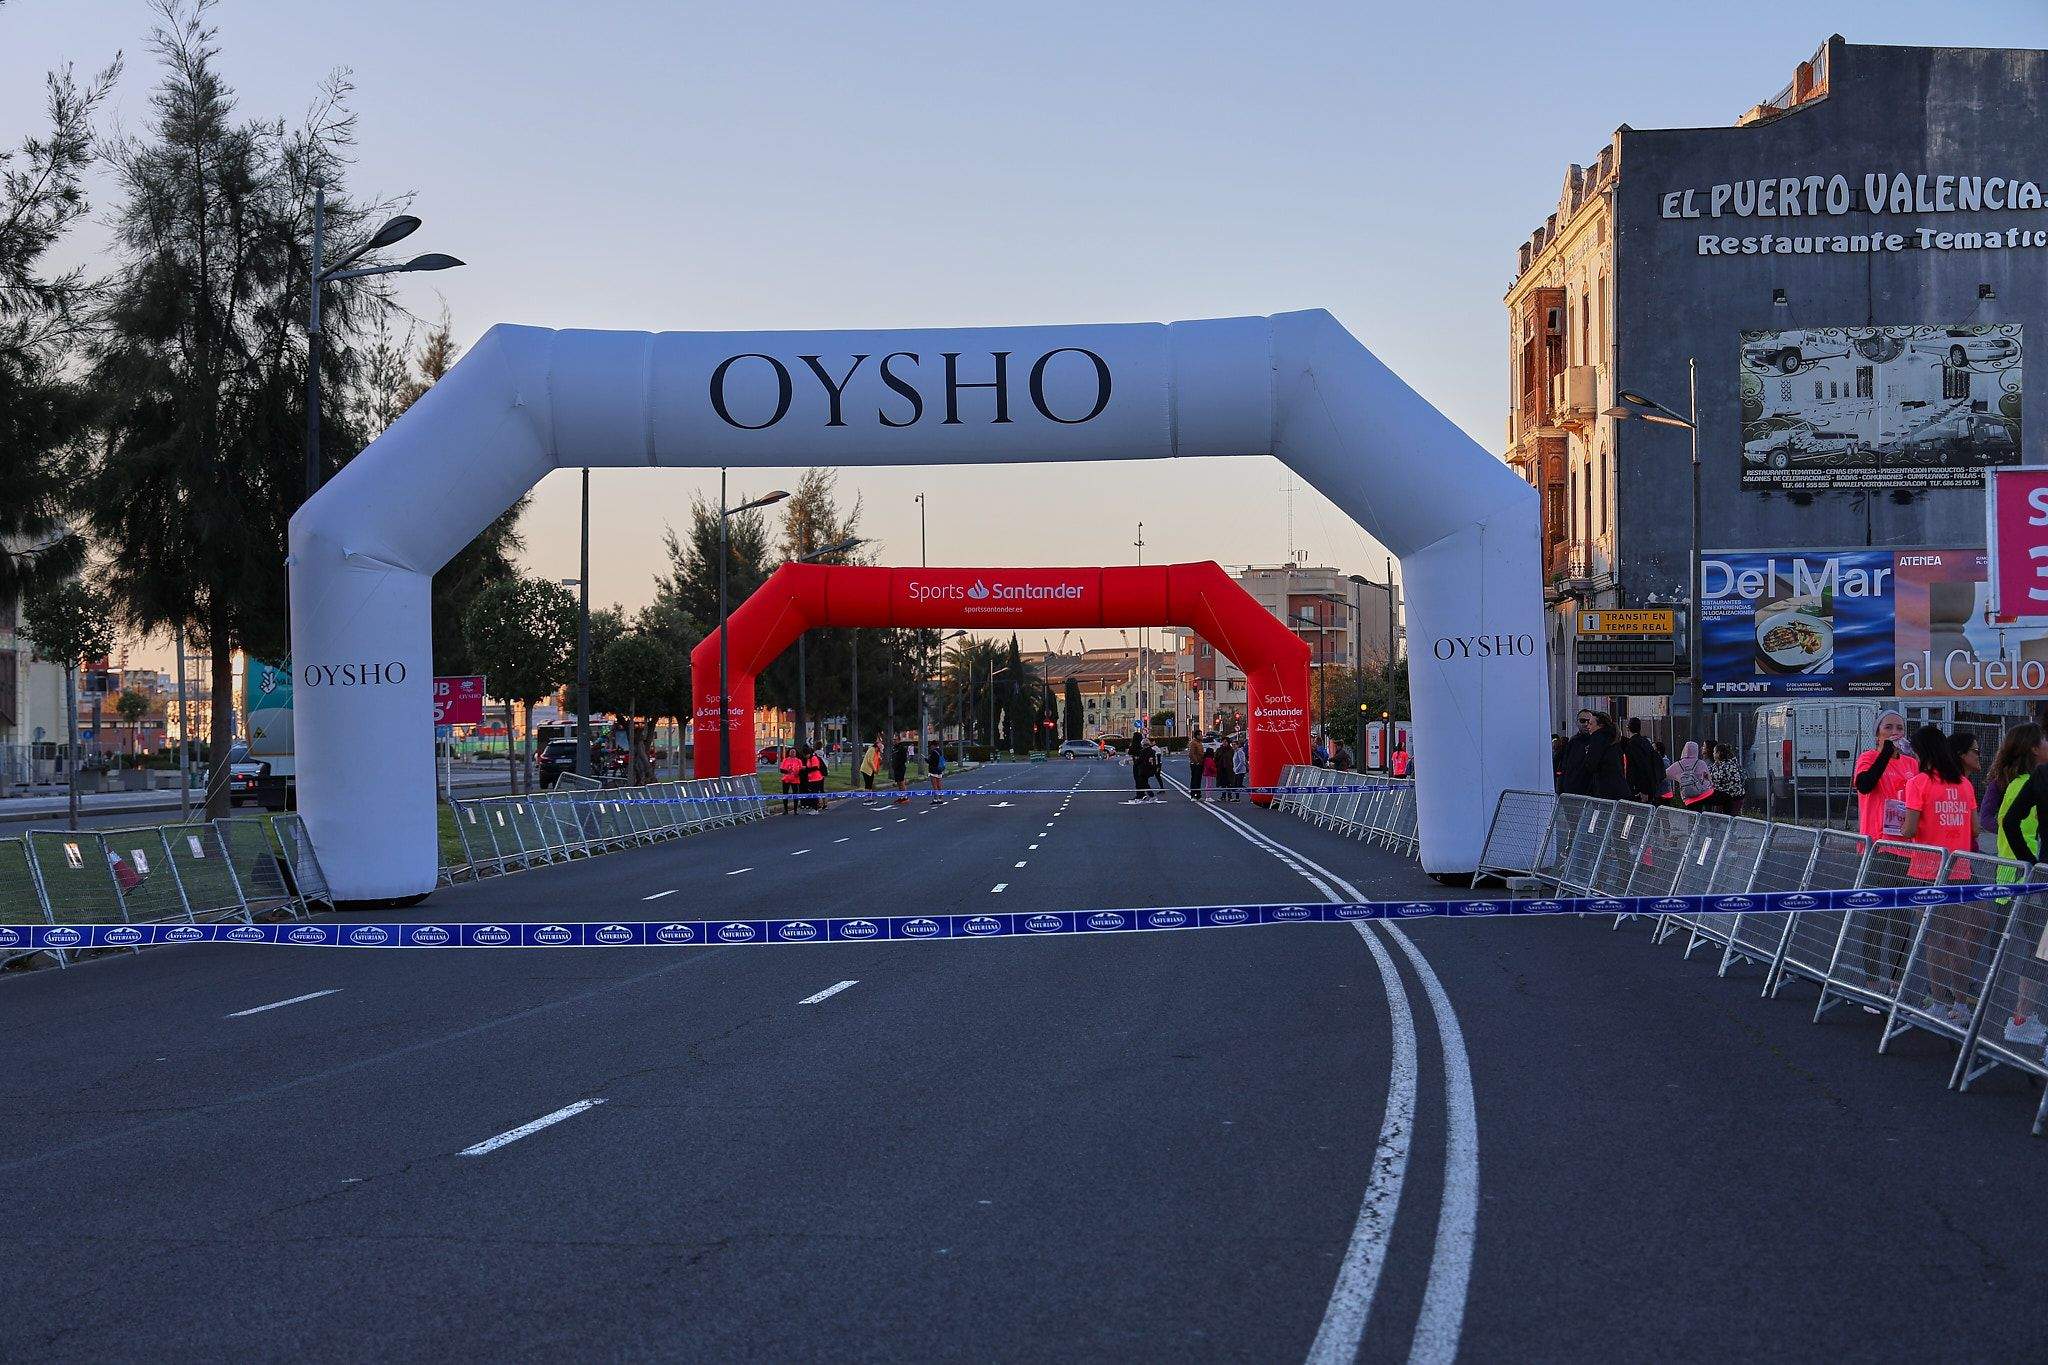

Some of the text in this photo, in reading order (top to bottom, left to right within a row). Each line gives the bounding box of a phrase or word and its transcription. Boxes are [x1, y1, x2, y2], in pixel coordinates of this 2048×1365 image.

[1662, 188, 1700, 219] EL
[1710, 174, 1850, 217] PUERTO
[1698, 231, 1904, 255] Restaurante
[709, 348, 1112, 430] OYSHO
[1899, 555, 1942, 566] ATENEA
[1701, 558, 1891, 599] Del Mar
[909, 582, 1084, 602] Sports Santander
[1652, 612, 1666, 620] EN
[1606, 623, 1668, 631] TEMPS REAL
[1433, 634, 1534, 660] OYSHO
[304, 661, 406, 687] OYSHO
[1900, 649, 2046, 691] al Cielo
[1716, 682, 1771, 692] FRONT
[705, 694, 732, 703] Spos
[1264, 694, 1292, 704] Sports
[1262, 707, 1303, 717] Santander
[1945, 787, 1958, 800] TU
[1935, 800, 1969, 814] DORSAL
[1939, 813, 1964, 826] SUMA
[1338, 907, 1371, 917] ASTURIANA
[1401, 905, 1433, 914] ASTURIANA
[1464, 904, 1496, 913] ASTURIANA
[1526, 904, 1558, 912] ASTURIANA
[1213, 912, 1246, 921] ASTURIANA
[1276, 909, 1308, 918] ASTURIANA
[1090, 918, 1122, 927] ASTURIANA
[1152, 915, 1184, 924] ASTURIANA
[966, 923, 998, 932] ASTURIANA
[1028, 920, 1060, 929] ASTURIANA
[721, 929, 753, 938] ASTURIANA
[782, 928, 814, 937] ASTURIANA
[843, 926, 876, 936] ASTURIANA
[905, 925, 936, 934] ASTURIANA
[47, 934, 77, 942] ASTURIANA
[107, 932, 139, 941] ASTURIANA
[169, 931, 201, 940] ASTURIANA
[230, 931, 262, 940] ASTURIANA
[291, 931, 323, 941] ASTURIANA
[353, 932, 385, 941] ASTURIANA
[415, 932, 447, 941] ASTURIANA
[476, 932, 508, 941] ASTURIANA
[537, 932, 569, 940] ASTURIANA
[598, 931, 630, 940] ASTURIANA
[660, 930, 692, 939] ASTURIANA
